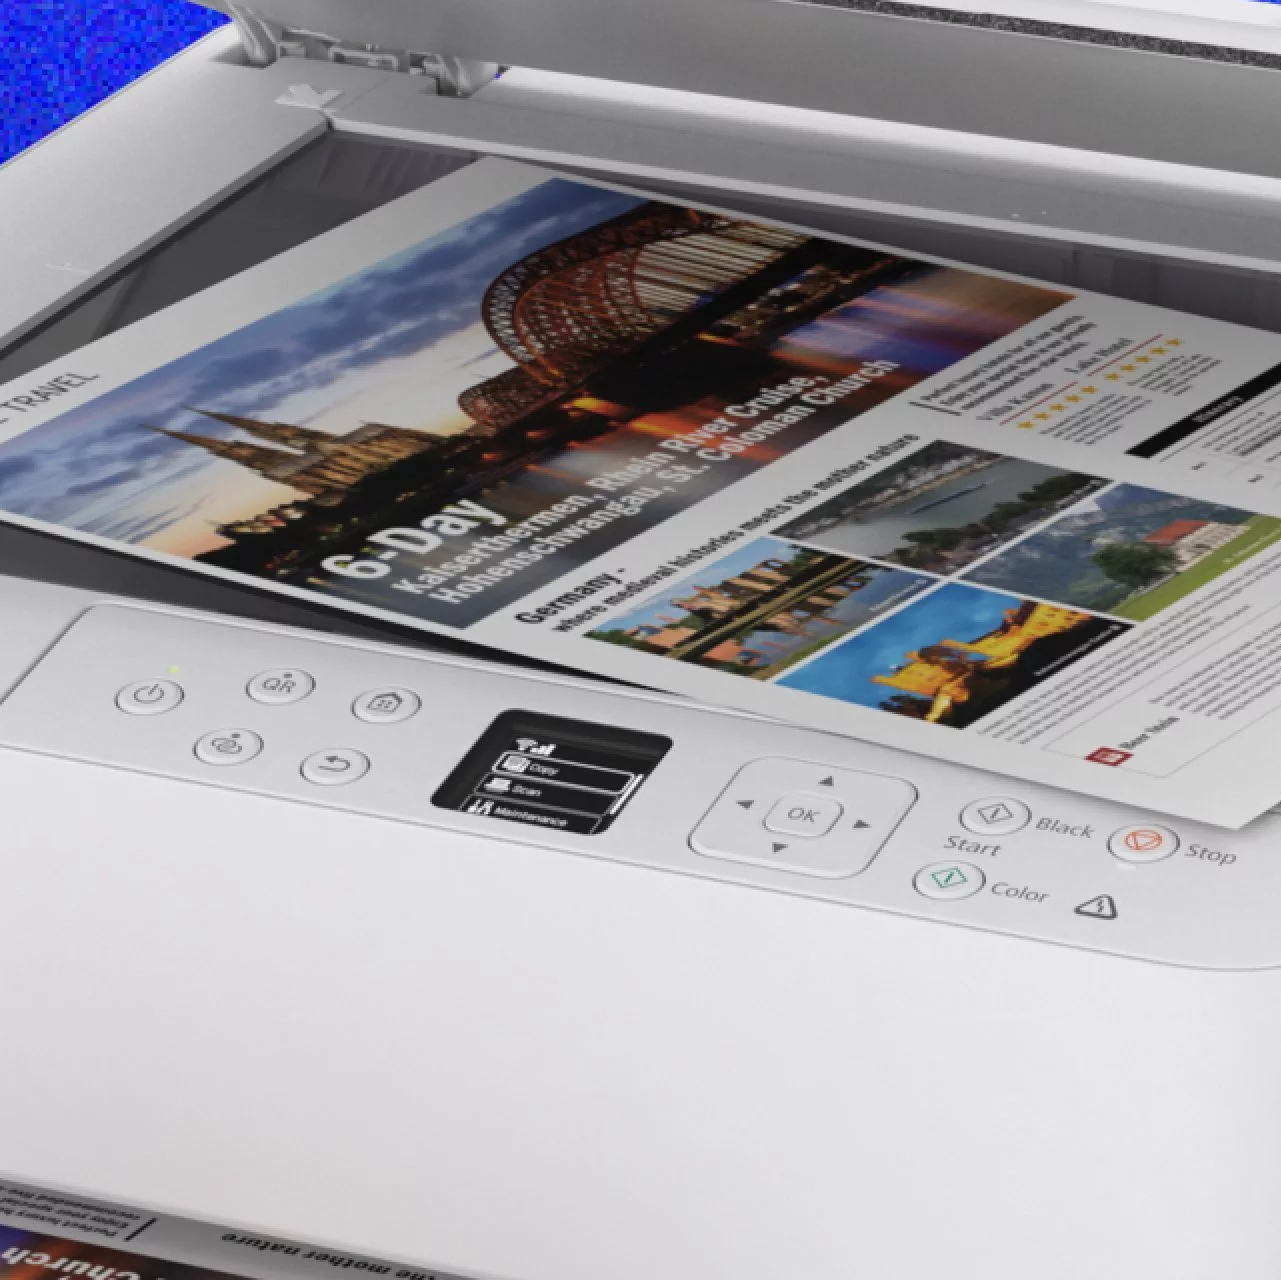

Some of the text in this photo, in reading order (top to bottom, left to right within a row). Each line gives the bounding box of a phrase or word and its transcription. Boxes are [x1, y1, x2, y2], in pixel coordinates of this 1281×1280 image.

[391, 375, 830, 595] Kaiserthermen, Rhein River Cruise,
[428, 359, 901, 605] Hohenschwangau, St. Coloman Church
[321, 498, 509, 580] 6-Day
[552, 434, 920, 632] where medieval histories meets the mother nature
[515, 572, 623, 625] Germany
[787, 806, 821, 823] OK
[1035, 817, 1095, 839] Black
[943, 835, 1002, 857] Start
[1183, 843, 1237, 866] Stop
[991, 881, 1051, 903] Color
[221, 1233, 302, 1256] nature
[303, 1250, 393, 1275] mother
